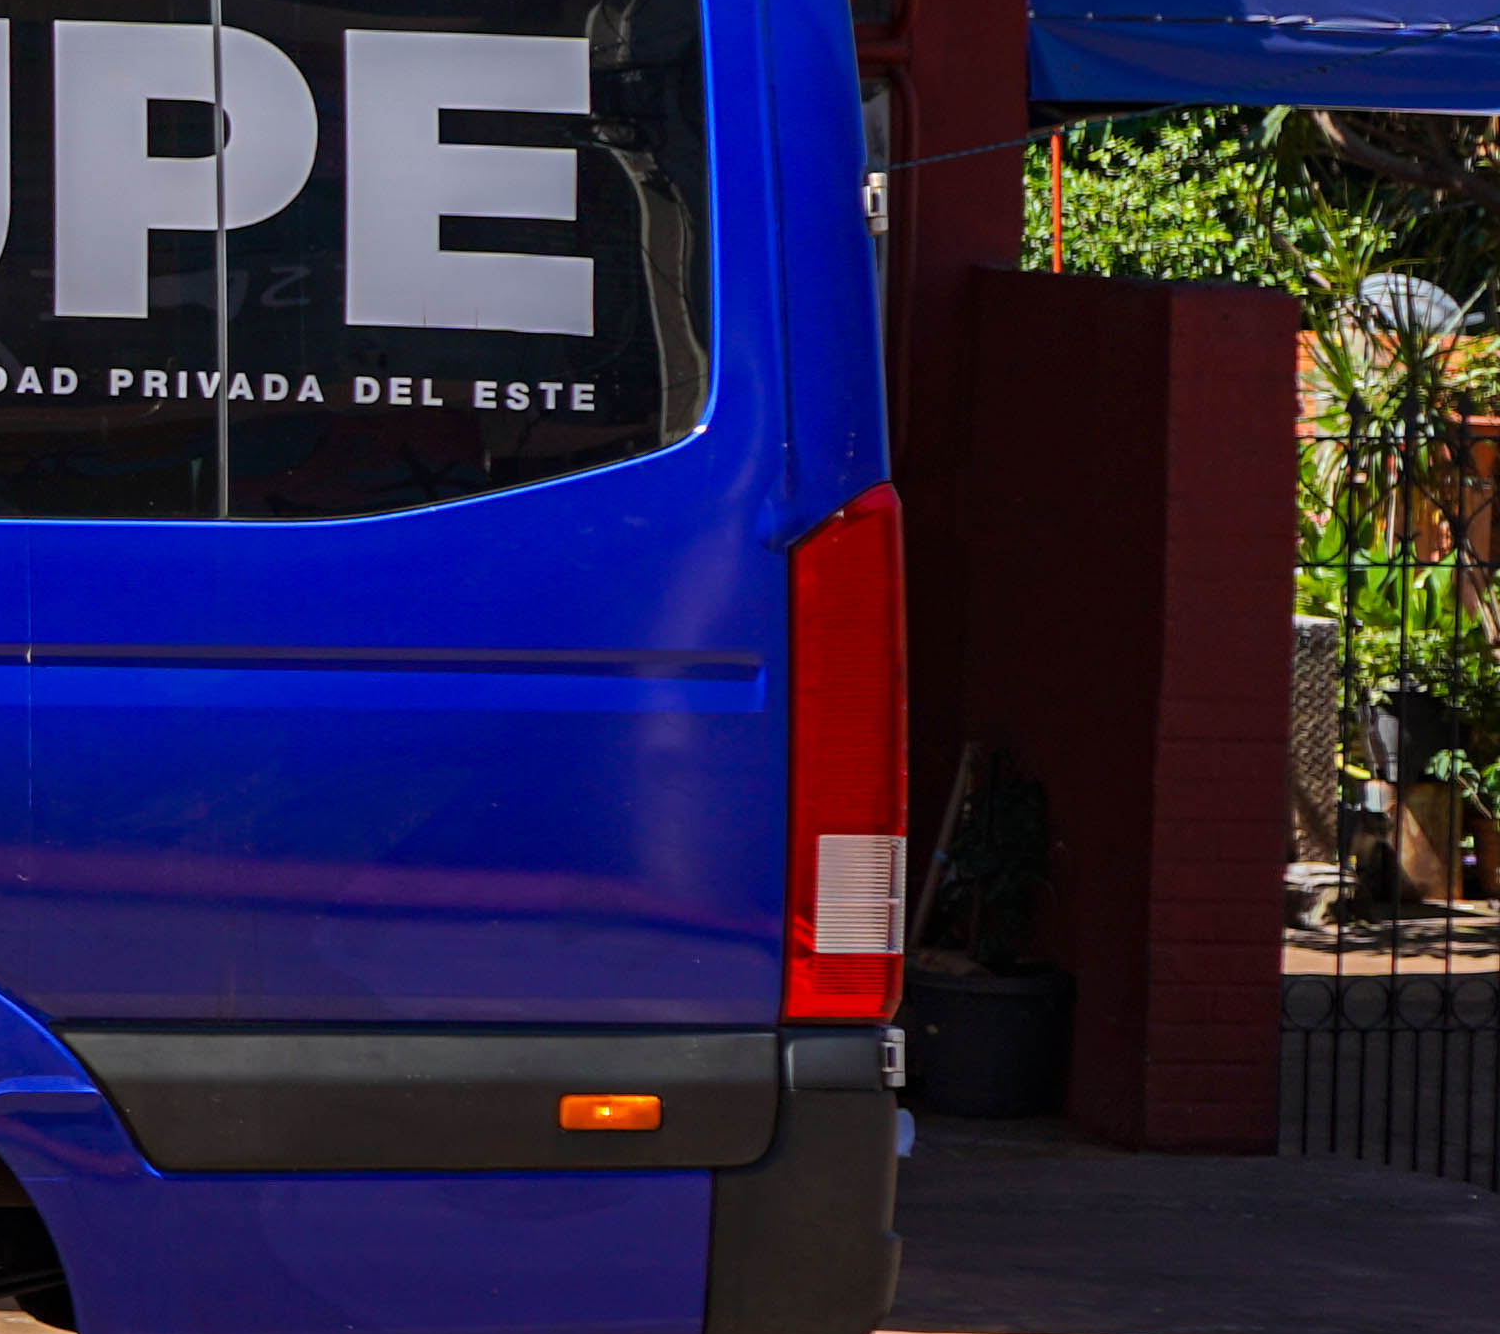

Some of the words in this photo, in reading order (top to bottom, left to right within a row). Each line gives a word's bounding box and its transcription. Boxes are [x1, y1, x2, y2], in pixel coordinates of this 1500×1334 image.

[109, 368, 325, 404] PRIVADA
[353, 375, 444, 408] DEL
[473, 381, 597, 413] ESTE
